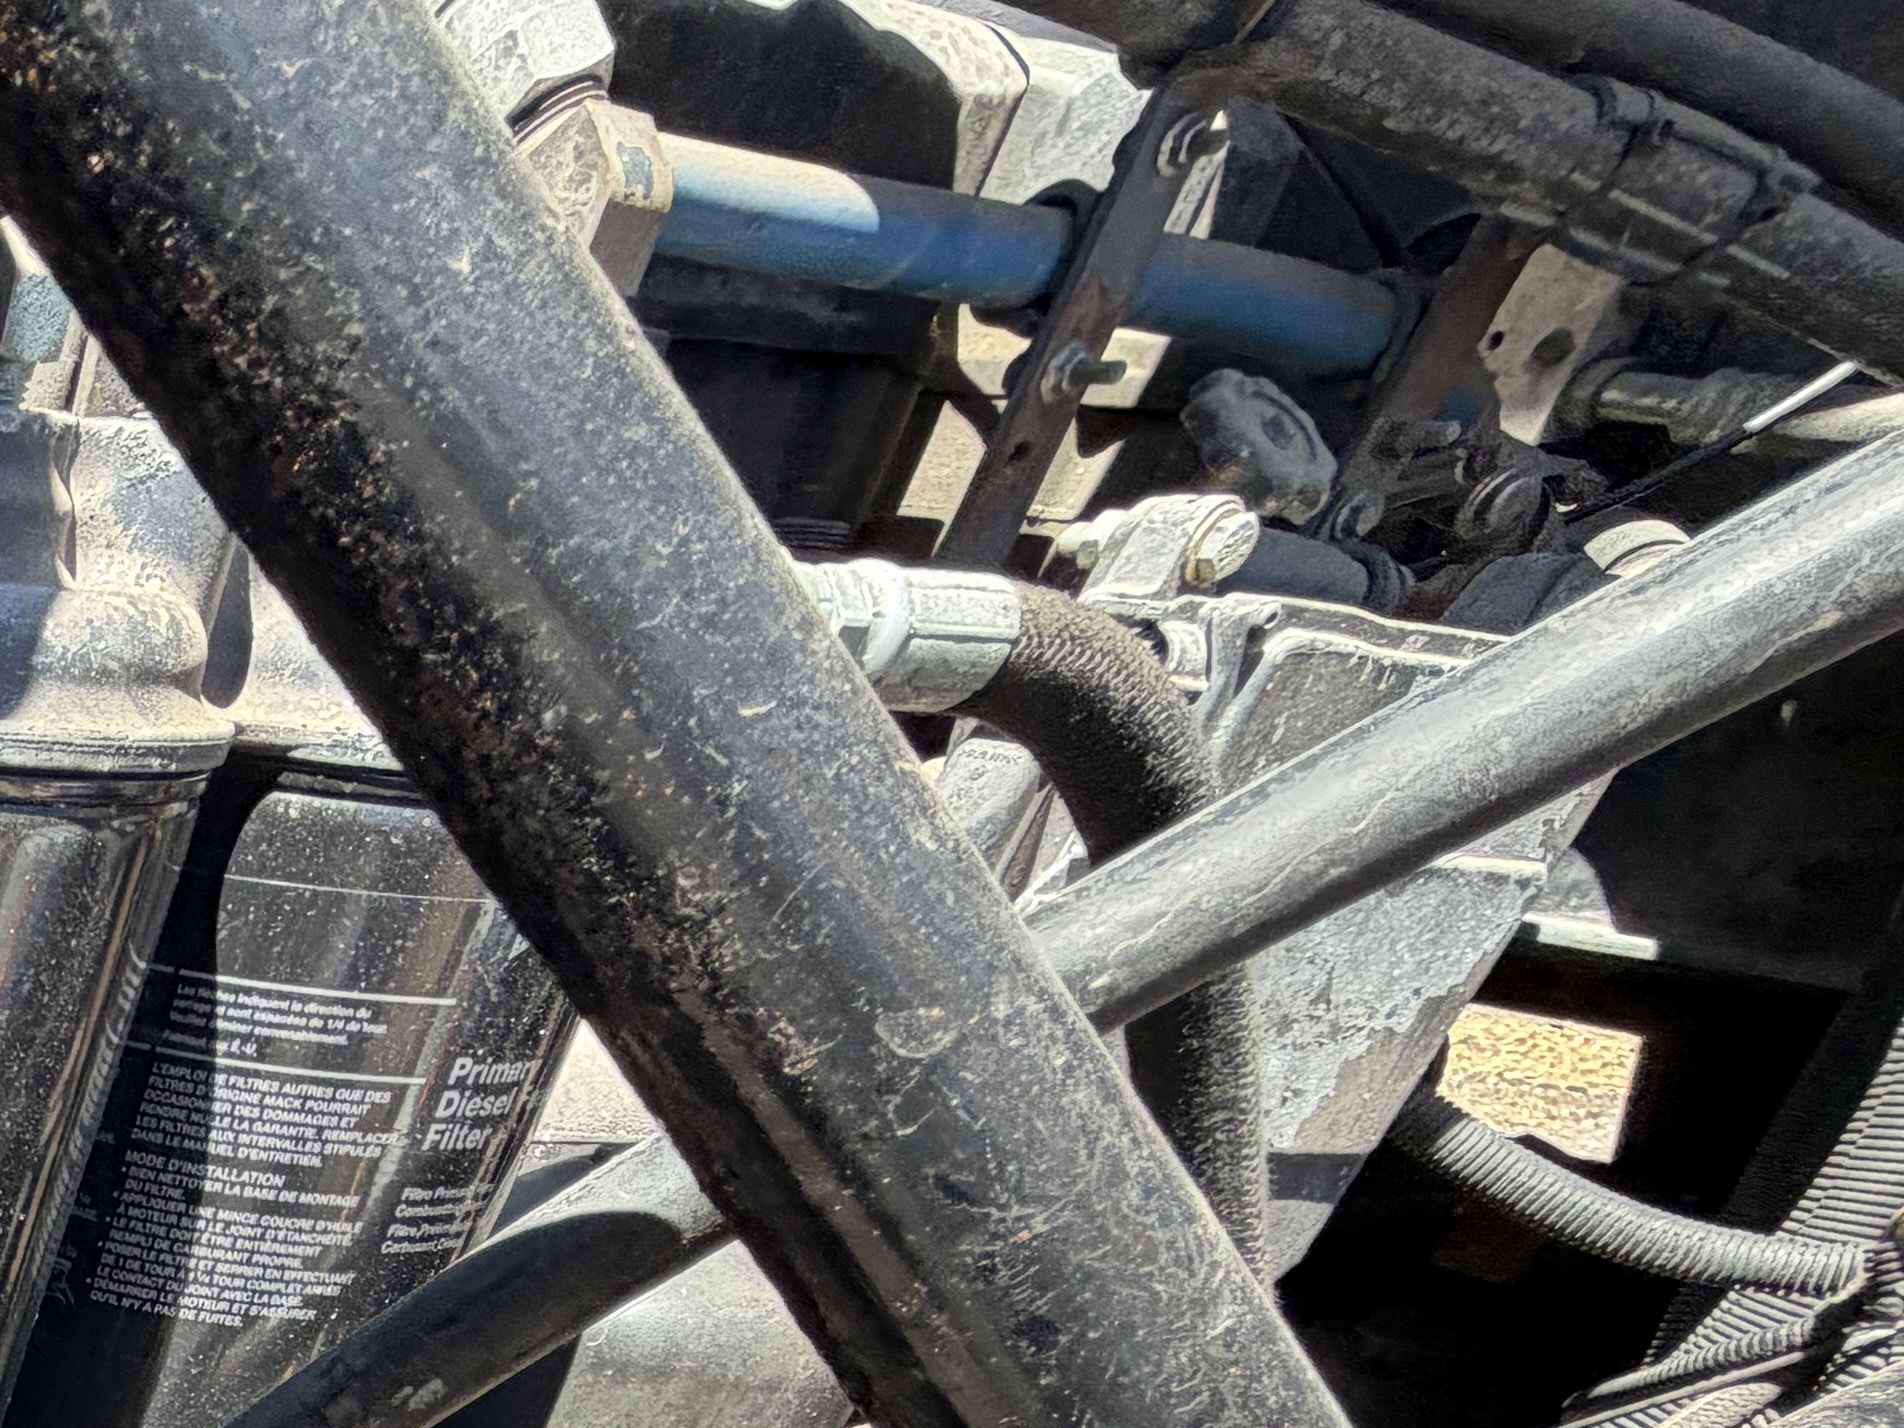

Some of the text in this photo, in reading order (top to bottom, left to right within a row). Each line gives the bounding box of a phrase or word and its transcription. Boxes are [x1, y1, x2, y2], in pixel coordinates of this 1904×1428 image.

[226, 1007, 252, 1019] sont
[308, 1018, 324, 1028] de
[326, 1019, 345, 1030] 1/4
[345, 1021, 361, 1032] de
[304, 1002, 355, 1019] direction
[356, 1008, 372, 1019] du
[447, 1056, 542, 1087] Primar
[146, 1077, 195, 1094] FILTRES
[262, 1094, 303, 1111] MACK
[303, 1101, 370, 1117] POURRAIT
[227, 1075, 280, 1093] FILTRES
[281, 1082, 334, 1100] AUTRES
[334, 1088, 364, 1103] QUE
[364, 1091, 391, 1104] DES
[435, 1087, 519, 1118] Diesel
[233, 1105, 261, 1119] DES
[262, 1109, 339, 1127] DOMMAGES
[339, 1117, 358, 1129] ET
[158, 1121, 207, 1138] FILTRES
[208, 1129, 236, 1143] AUX
[236, 1133, 322, 1153] INTERVALLES
[231, 1120, 251, 1131] LA
[251, 1121, 321, 1141] GARANTIE.
[422, 1123, 493, 1150] Filter
[123, 1151, 286, 1188] MODE D'INSTALLATION
[127, 1167, 359, 1208] BIEN NETTOYER LA BASE DE MONTAGE
[206, 1222, 225, 1234] LE
[225, 1224, 263, 1239] JOINT
[197, 1260, 215, 1272] ET
[263, 1269, 282, 1280] EN
[210, 1275, 246, 1289] TOUR
[165, 1281, 184, 1292] DU
[219, 1290, 252, 1302] AVEC
[252, 1294, 269, 1305] LA
[153, 1305, 177, 1317] PAS
[177, 1309, 197, 1321] DE
[197, 1312, 245, 1328] FUITES.
[230, 1303, 248, 1315] ET
